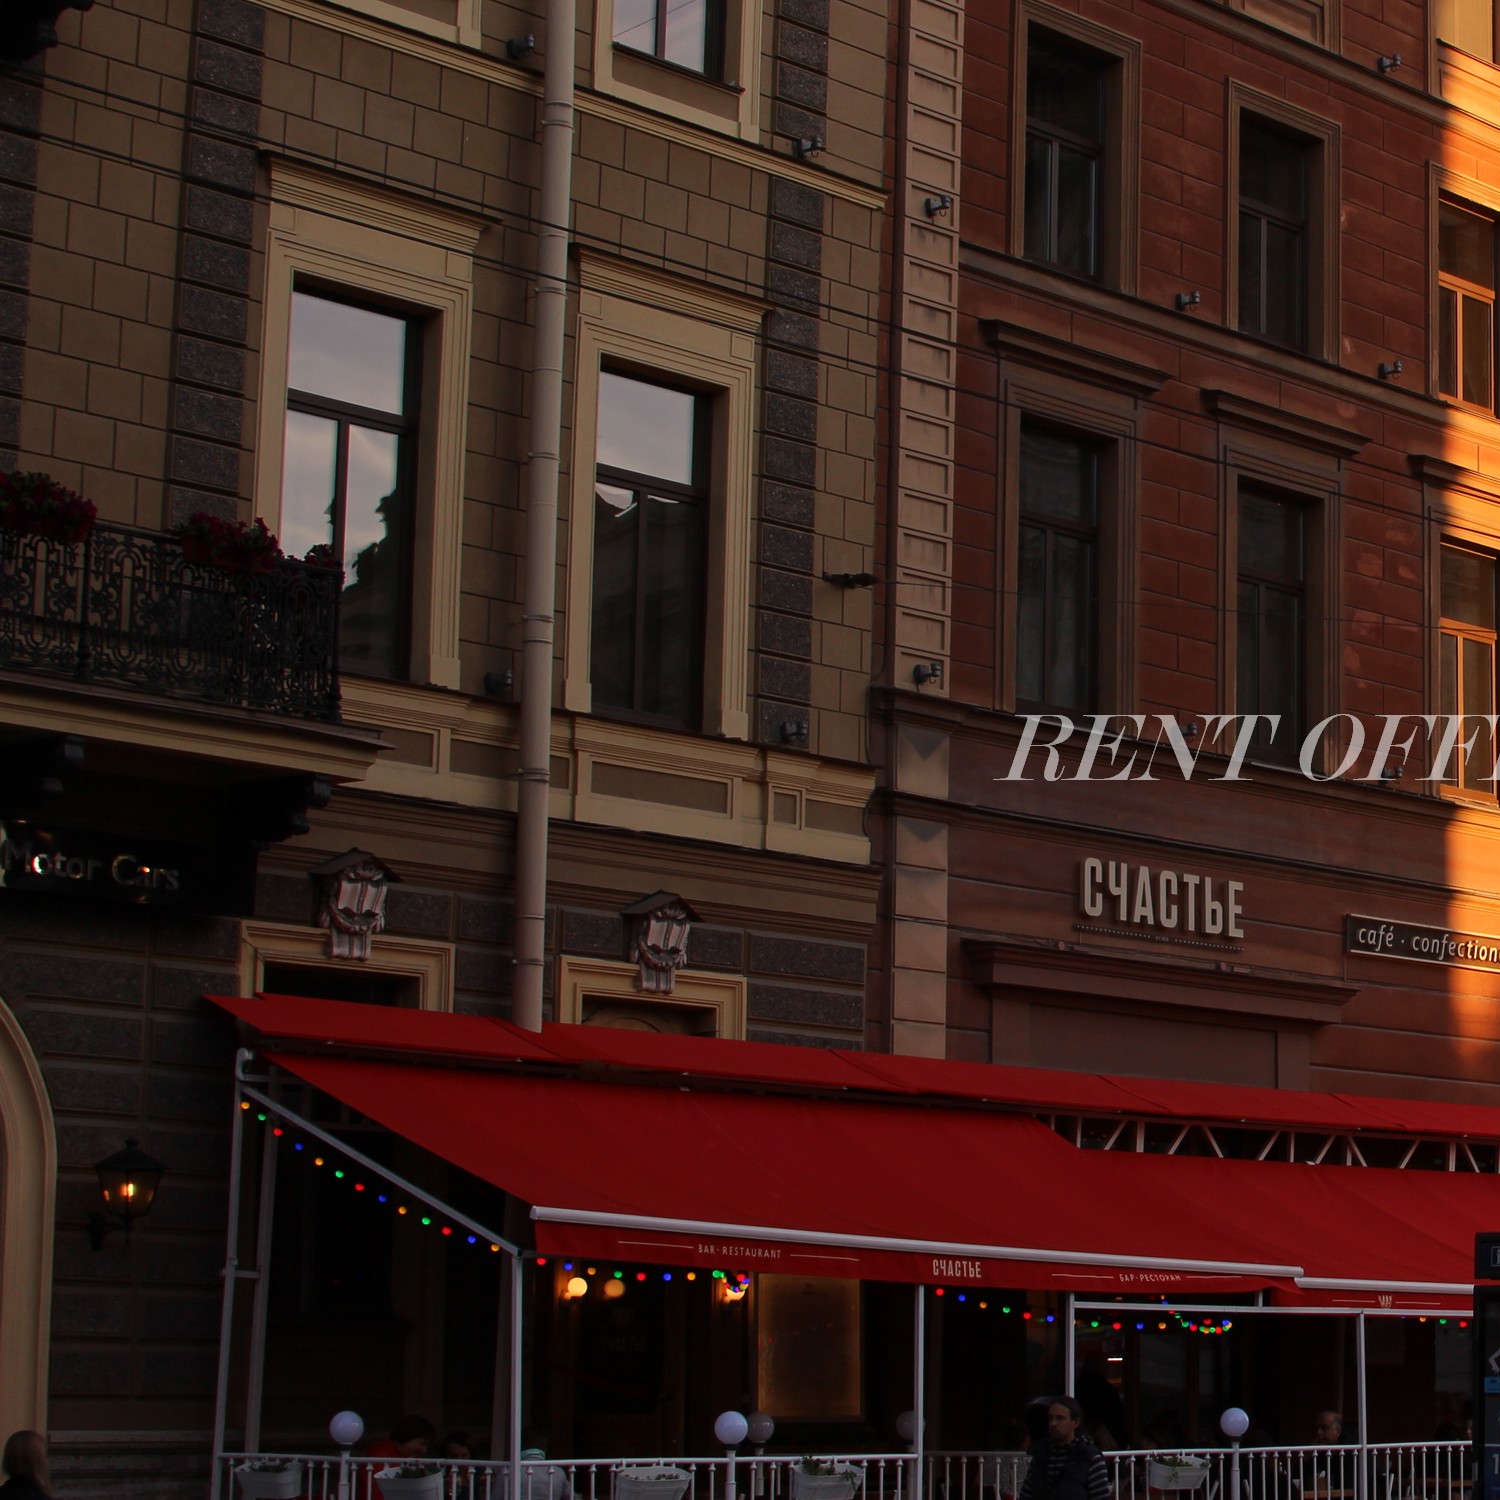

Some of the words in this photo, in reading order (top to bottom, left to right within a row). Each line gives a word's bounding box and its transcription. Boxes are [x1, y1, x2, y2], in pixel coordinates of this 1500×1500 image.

[2, 839, 102, 880] Motor
[111, 853, 180, 891] Cars
[1083, 857, 1244, 938] СЧАСТЬЕ
[1358, 925, 1394, 951] café
[698, 1244, 715, 1254] BAR
[722, 1246, 781, 1259] RESTAURANT
[933, 1259, 981, 1278] СЧАСТЬЕ
[1140, 1273, 1182, 1282] РЕСТОРАН
